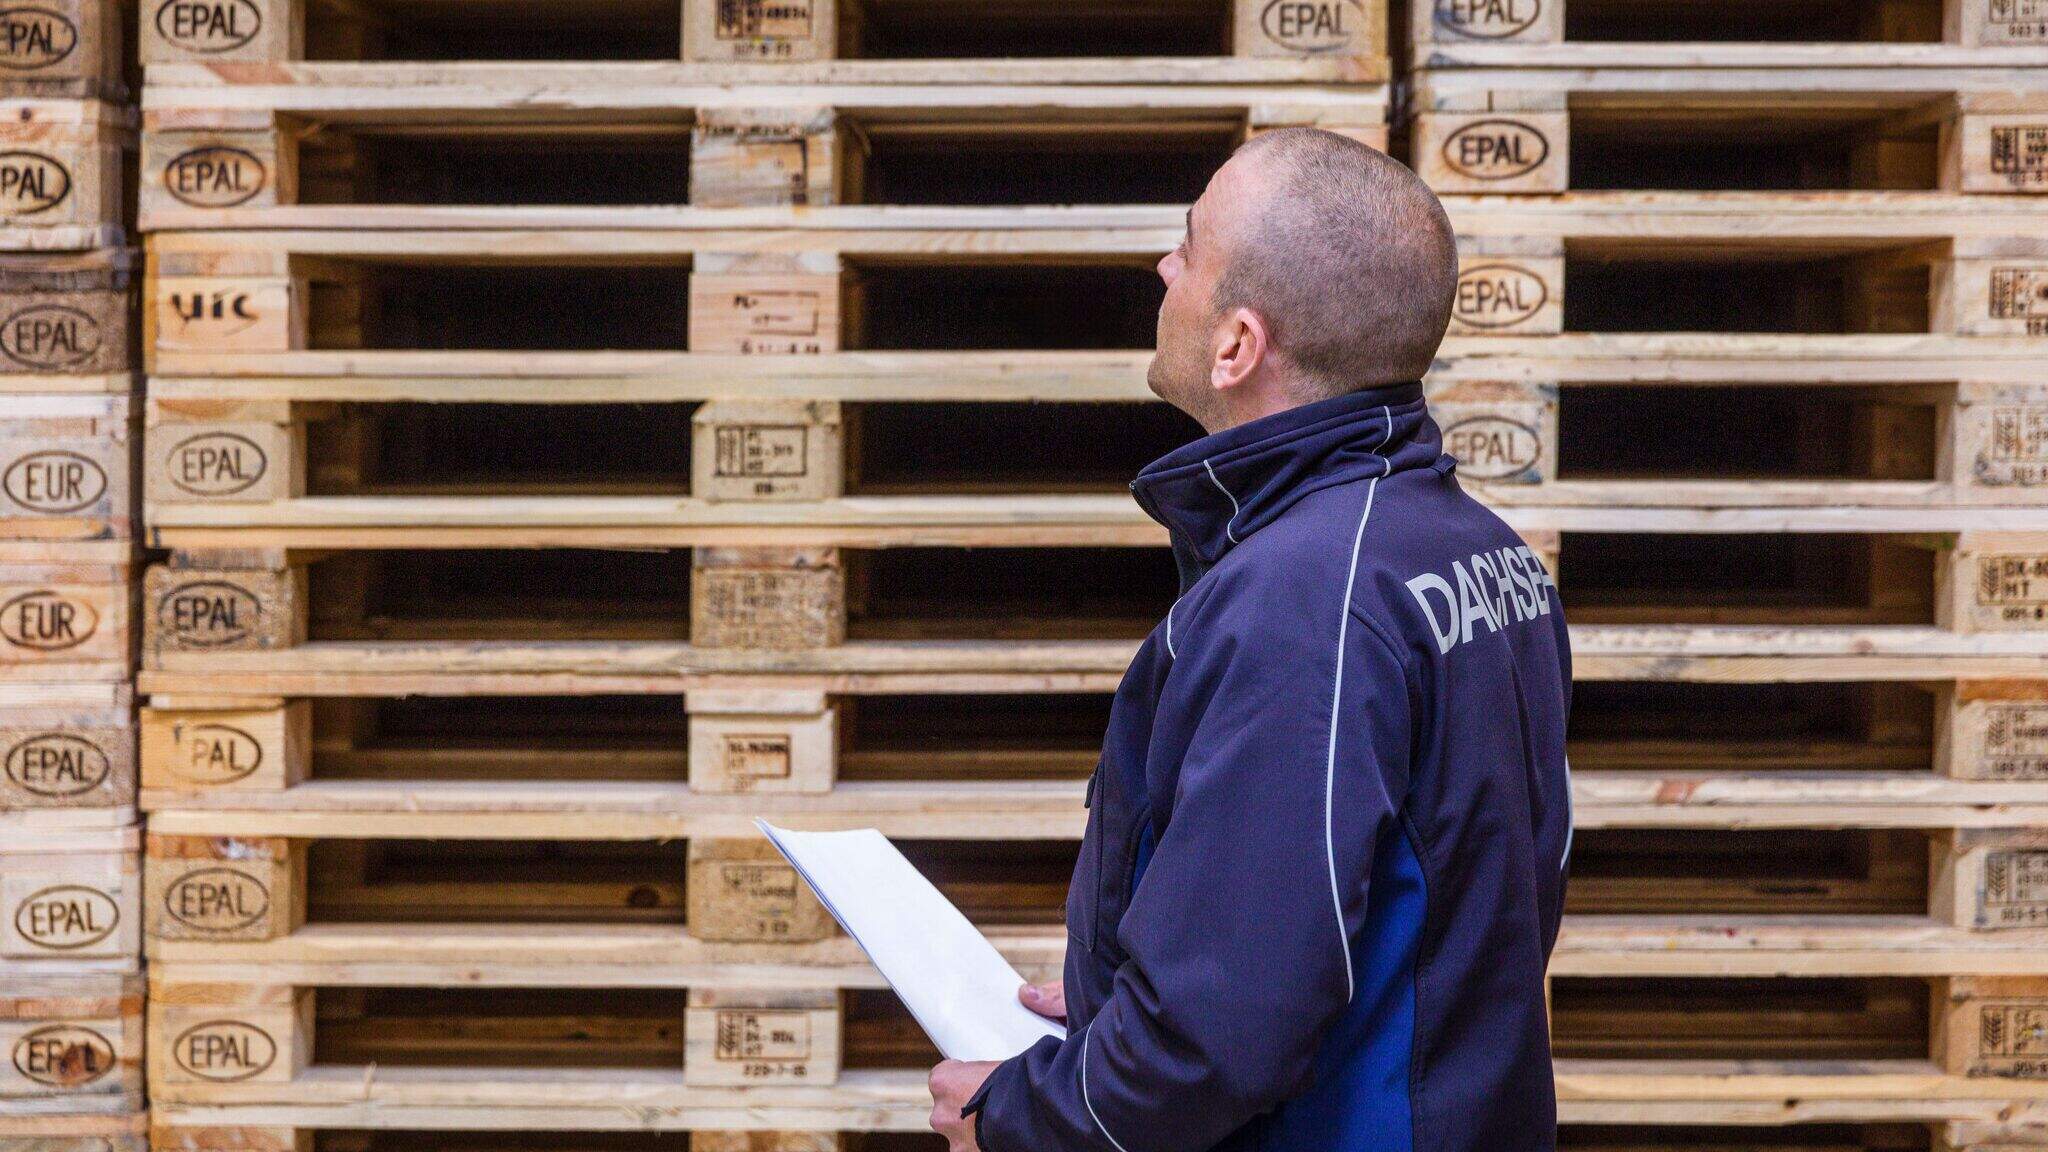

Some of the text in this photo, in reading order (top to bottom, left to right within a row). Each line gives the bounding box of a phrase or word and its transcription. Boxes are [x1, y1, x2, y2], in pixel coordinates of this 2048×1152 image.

[174, 4, 246, 38] EPAL
[1278, 2, 1349, 37] EPAL
[1459, 135, 1529, 166] EPAL
[177, 169, 249, 194] EPAL
[1459, 280, 1530, 314] EPAL
[15, 321, 86, 352] EPAL
[181, 447, 252, 483] EPAL
[1452, 432, 1524, 466] EPAL
[25, 462, 84, 501] EUR
[20, 602, 76, 640] EUR
[173, 597, 241, 631] EPAL
[23, 749, 94, 784] EPAL
[180, 883, 253, 918] EPAL
[29, 901, 103, 936] EPAL
[188, 1034, 259, 1068] EPAL
